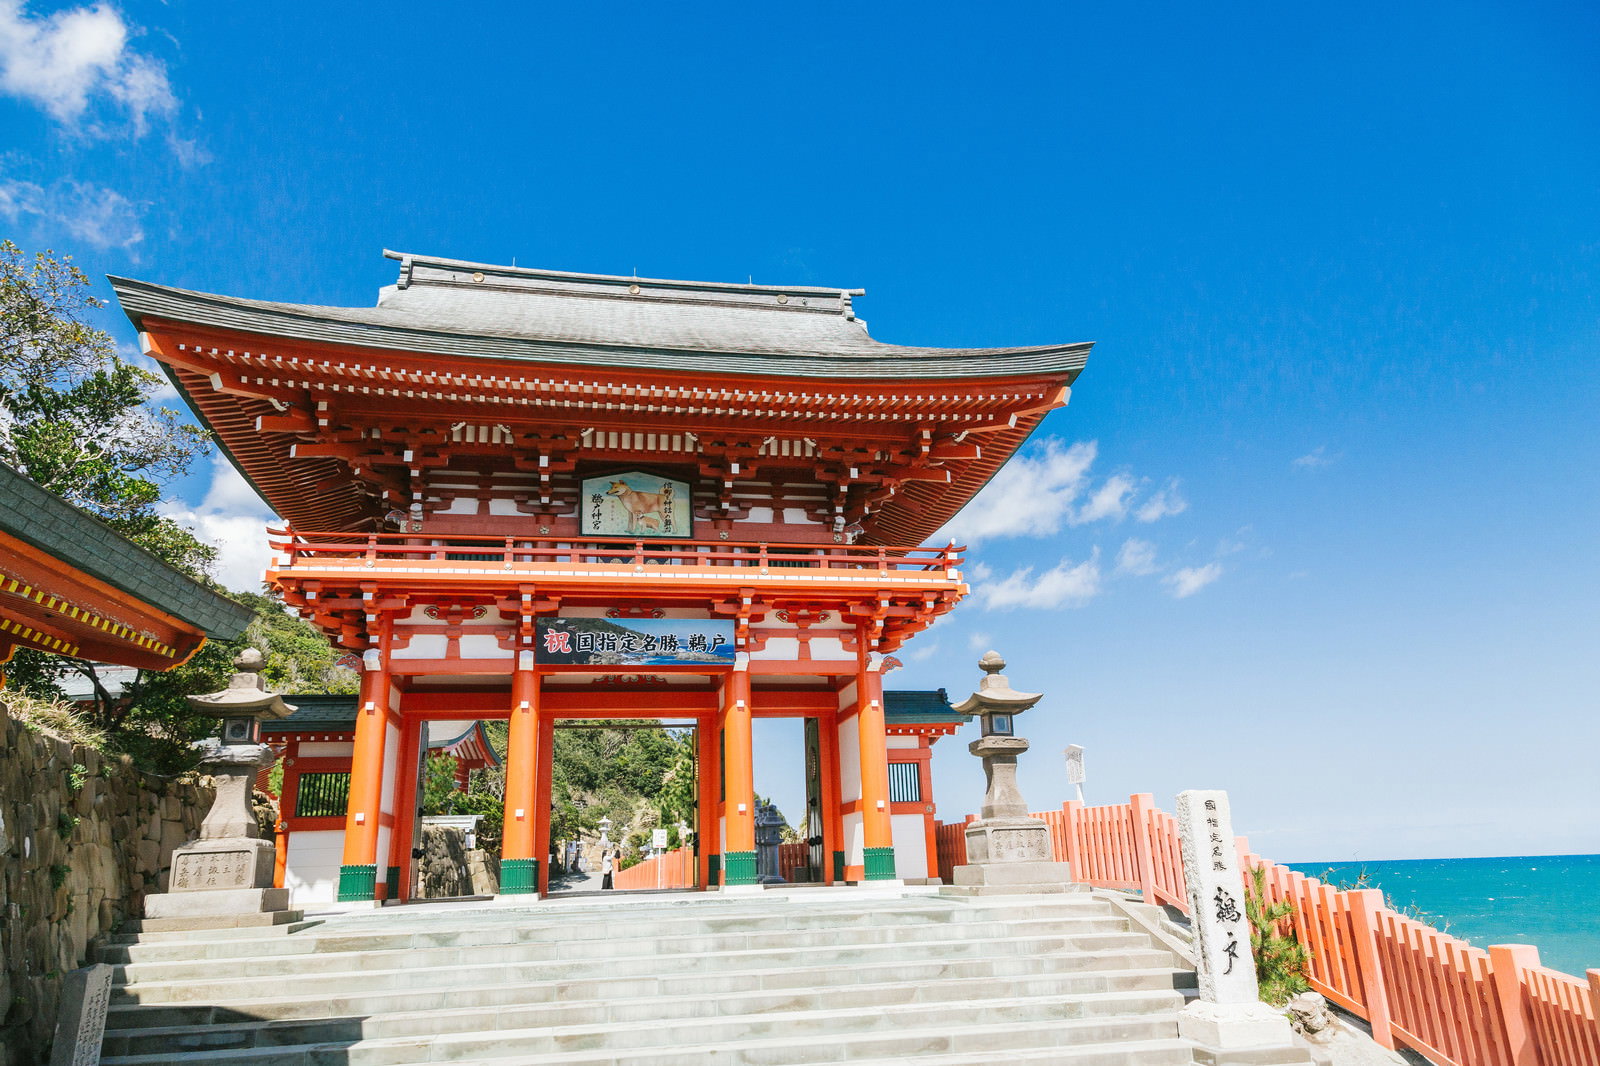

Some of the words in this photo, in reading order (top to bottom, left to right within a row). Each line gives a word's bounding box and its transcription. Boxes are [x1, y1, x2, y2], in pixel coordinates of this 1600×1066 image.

[544, 628, 572, 653] 祝
[576, 632, 679, 653] 国指定名勝
[688, 632, 727, 653] 鵜戸
